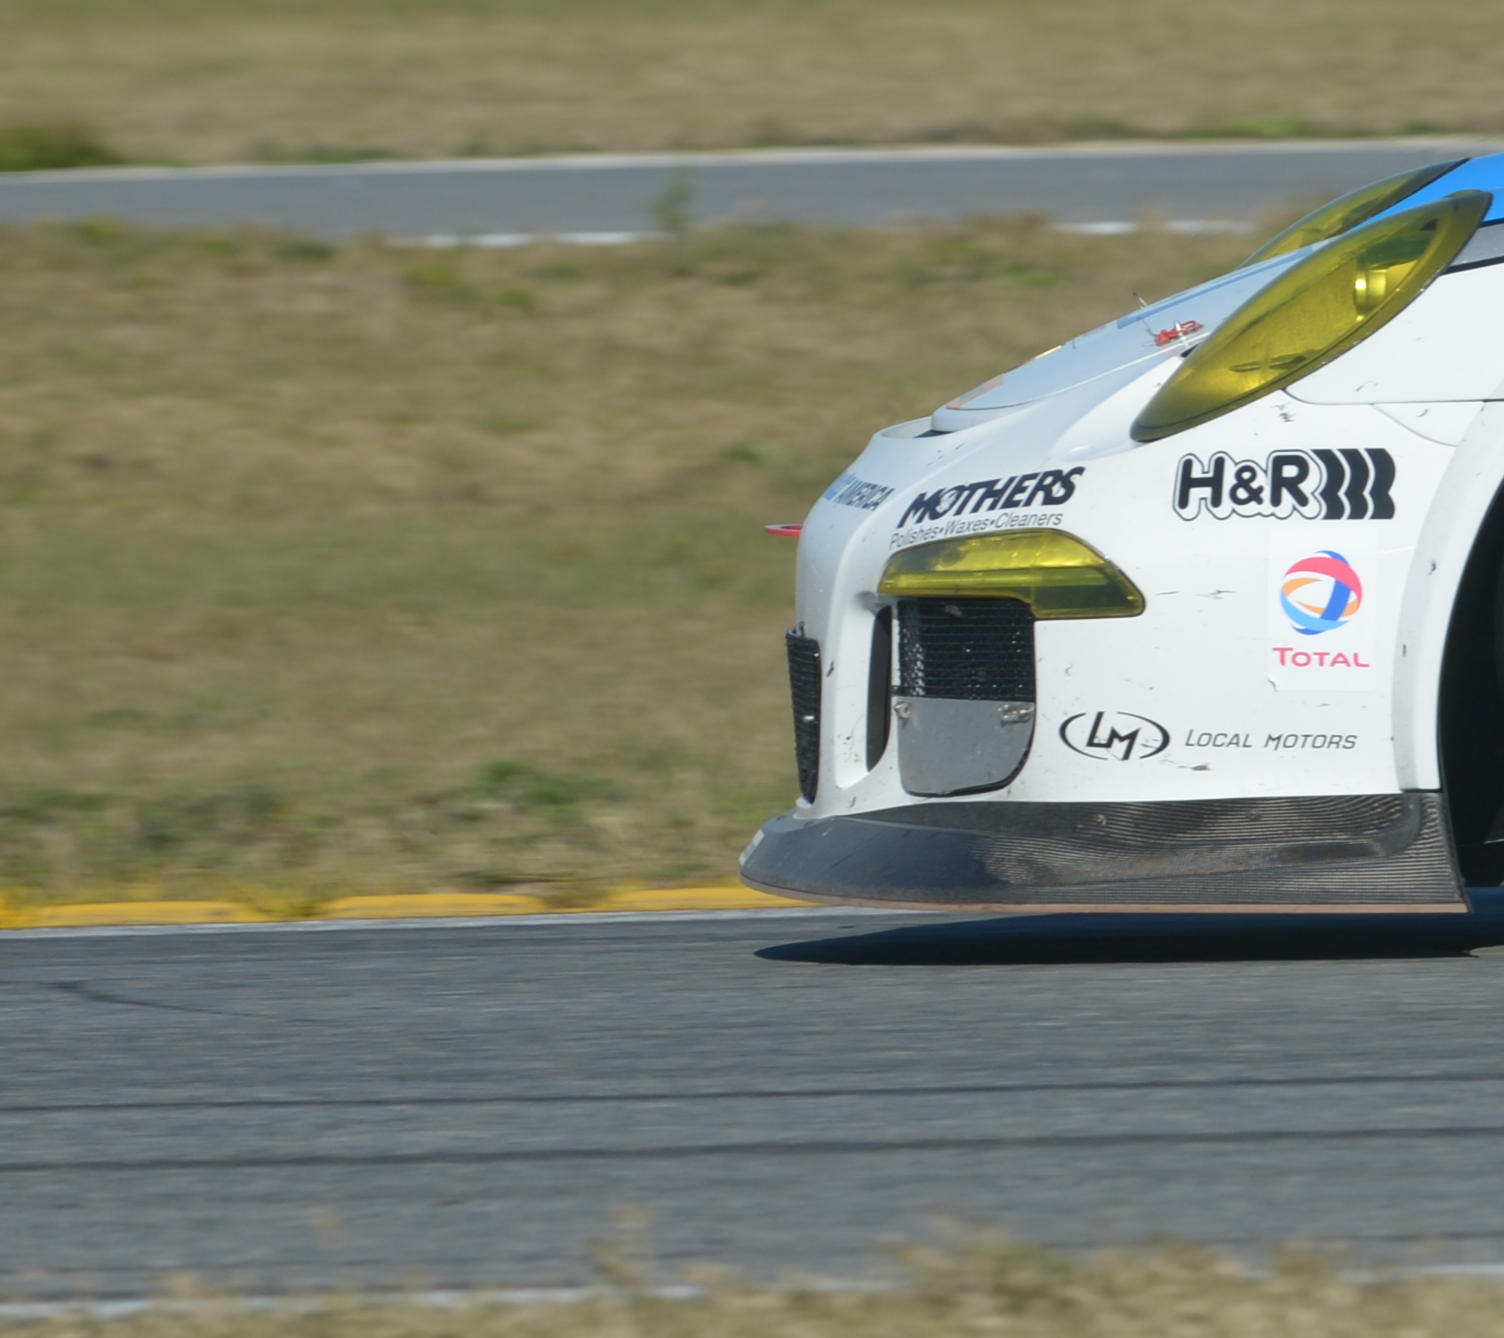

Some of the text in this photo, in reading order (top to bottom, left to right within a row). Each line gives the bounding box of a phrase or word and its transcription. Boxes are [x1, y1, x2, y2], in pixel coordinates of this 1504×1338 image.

[897, 466, 1086, 528] MOTHERS
[1175, 451, 1320, 516] H&R
[1272, 647, 1370, 669] TOTAL
[1185, 730, 1358, 751] LOCAL MOTORS
